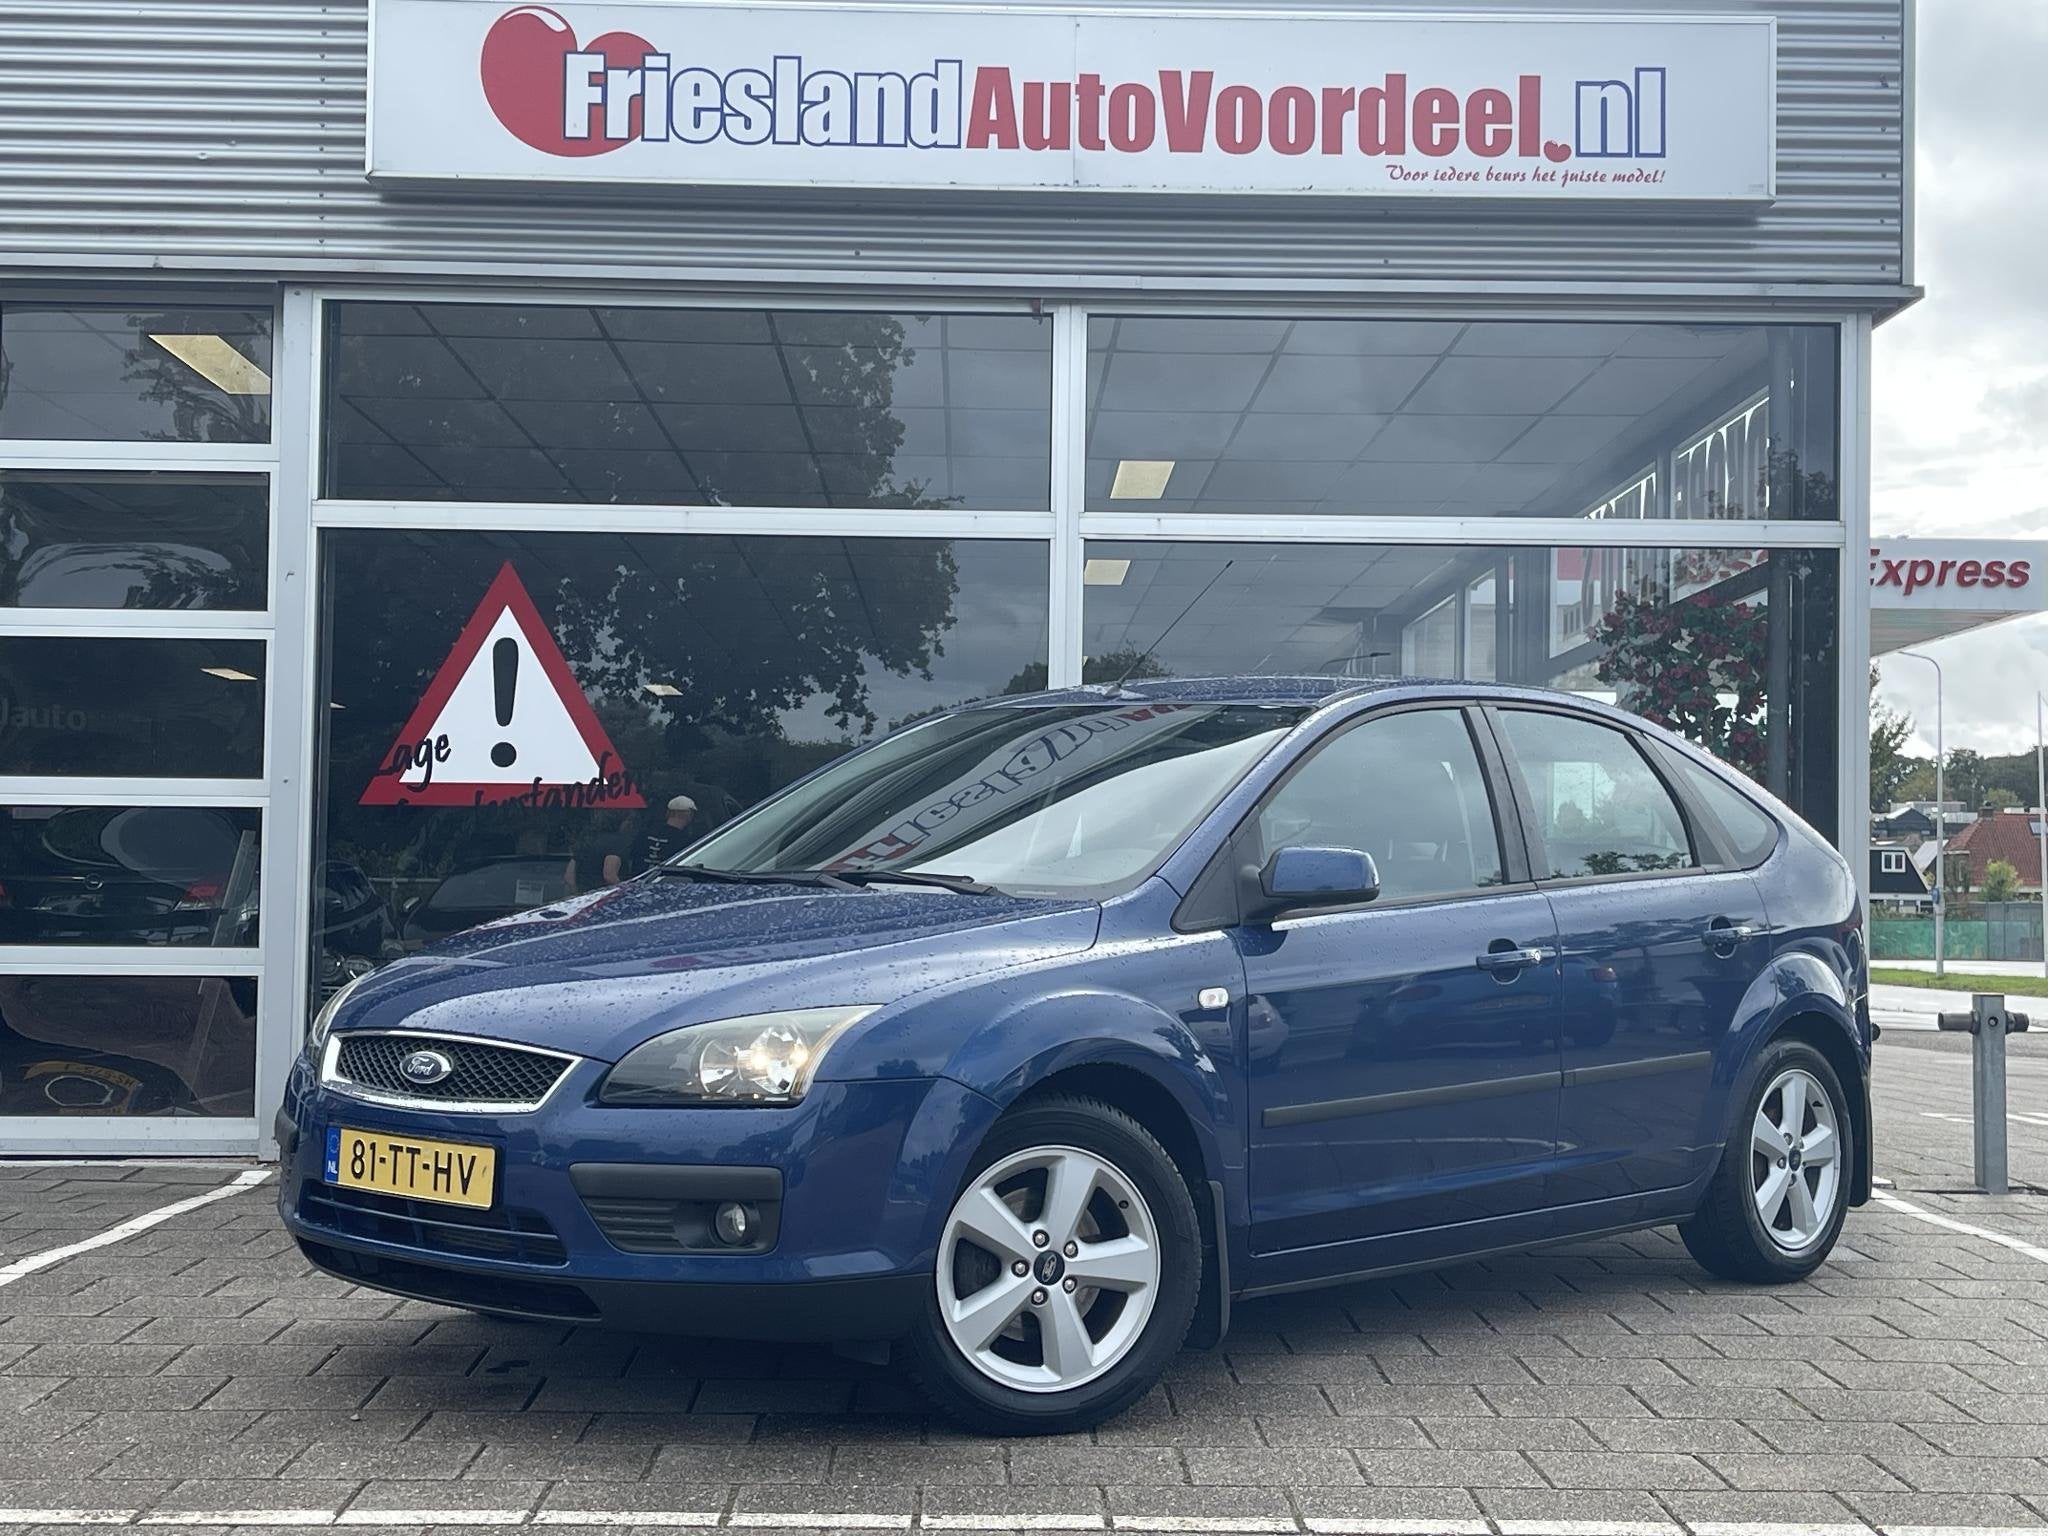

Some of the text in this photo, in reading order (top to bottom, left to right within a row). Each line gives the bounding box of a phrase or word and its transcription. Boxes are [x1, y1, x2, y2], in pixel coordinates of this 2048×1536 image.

[562, 51, 1667, 162] FrieslandAutoVoordeel.nl
[1386, 164, 1666, 188] Voor iedere beurs het juiste model!
[407, 1056, 435, 1075] Ford
[351, 1138, 477, 1196] 81-TT-HV
